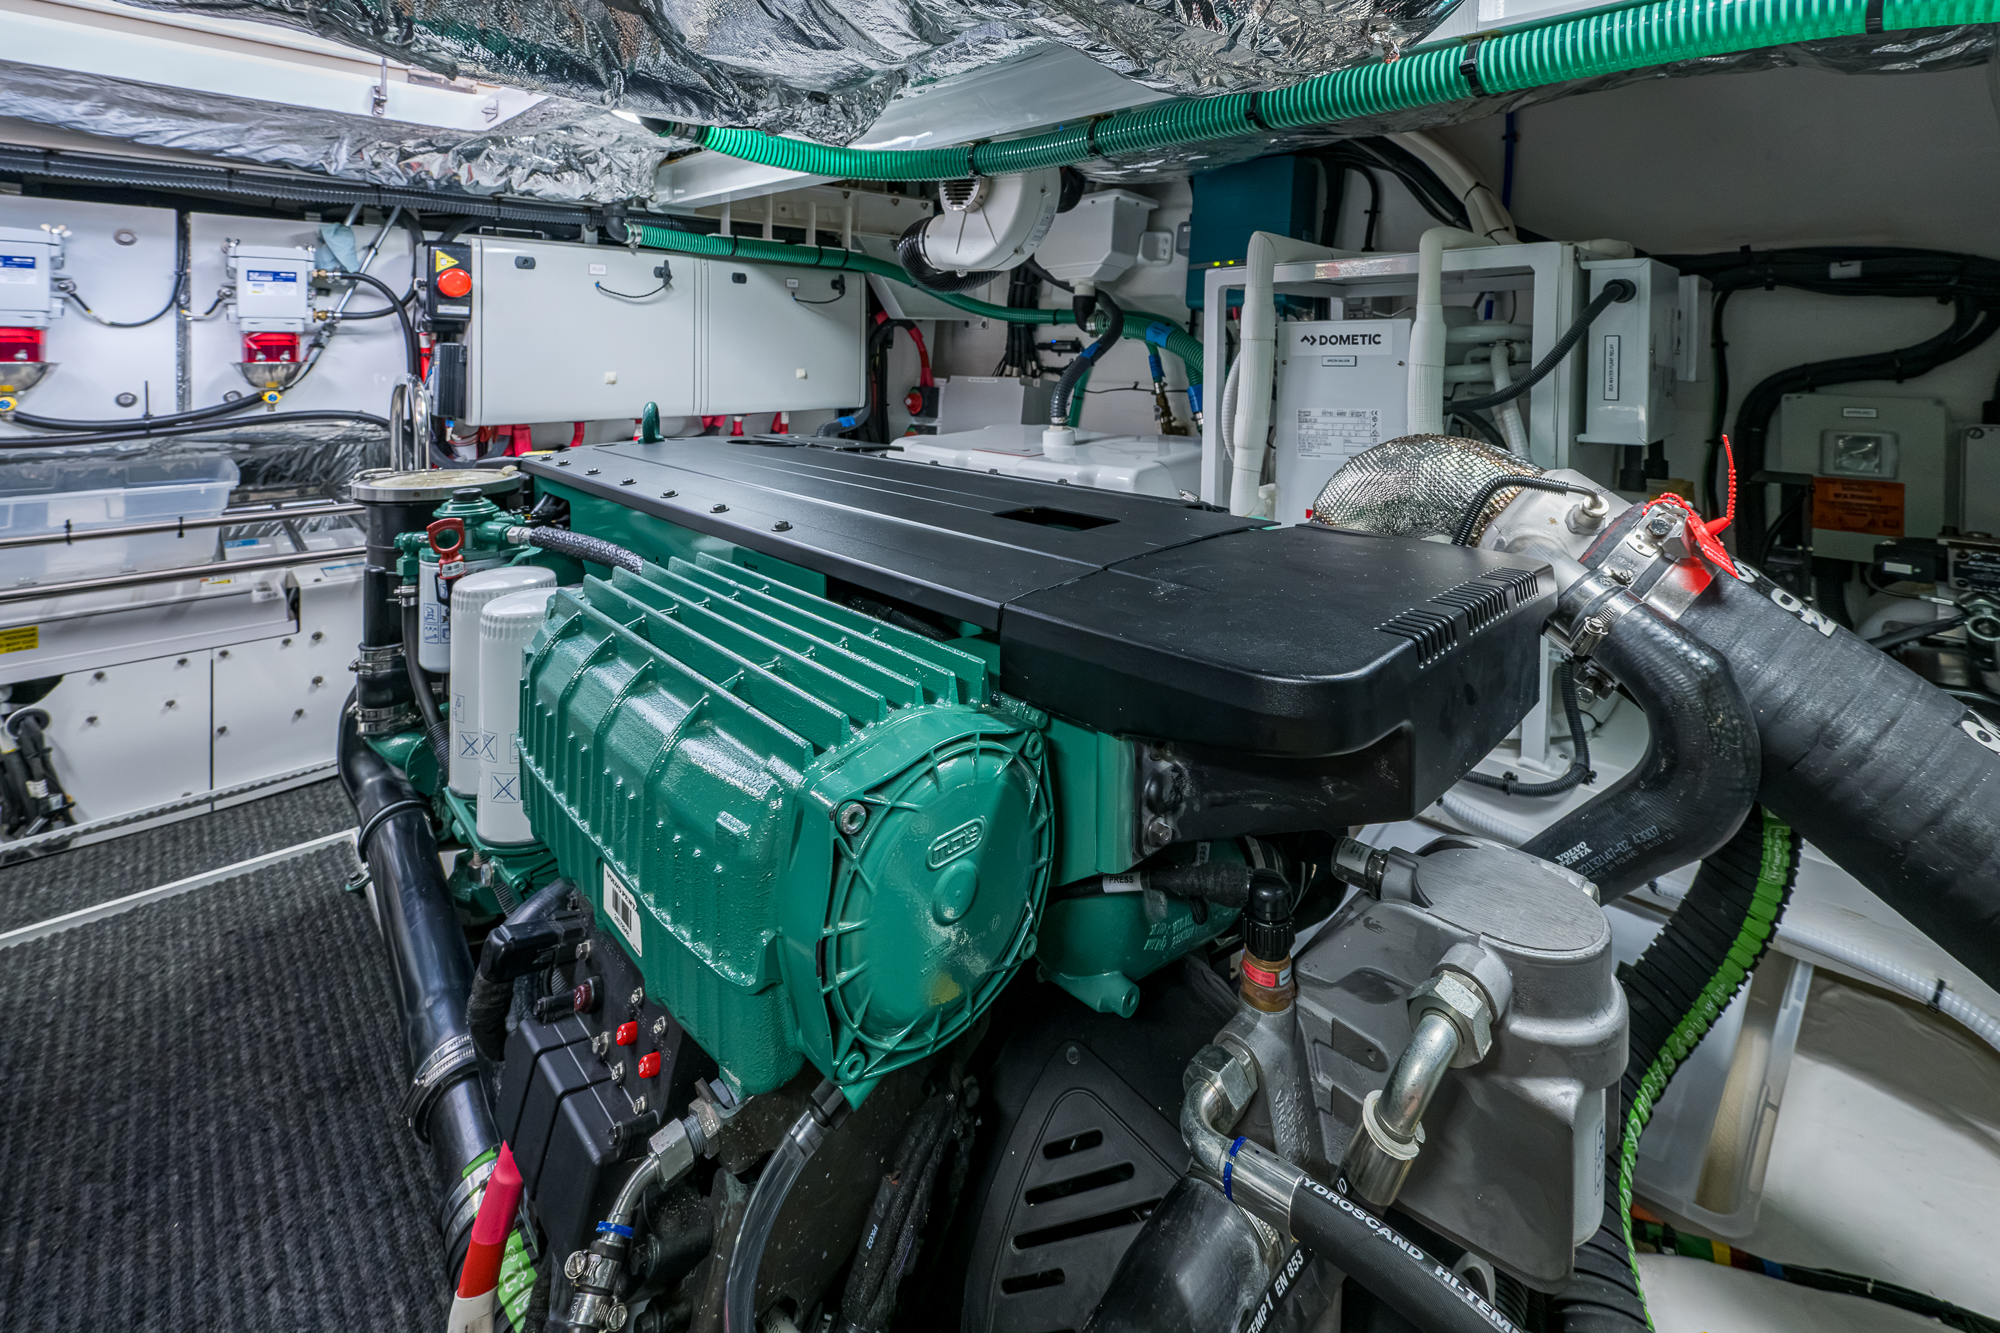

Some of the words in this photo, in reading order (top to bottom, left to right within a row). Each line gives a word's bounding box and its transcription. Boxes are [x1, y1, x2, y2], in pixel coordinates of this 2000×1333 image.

[1319, 333, 1382, 346] DOMETIC
[1555, 841, 1587, 862] VOLVO
[1558, 847, 1593, 867] PENTA
[1108, 875, 1135, 884] PRESS
[1302, 1176, 1425, 1261] YDROSCAND
[1274, 1270, 1289, 1298] EN
[1286, 1249, 1304, 1279] 853
